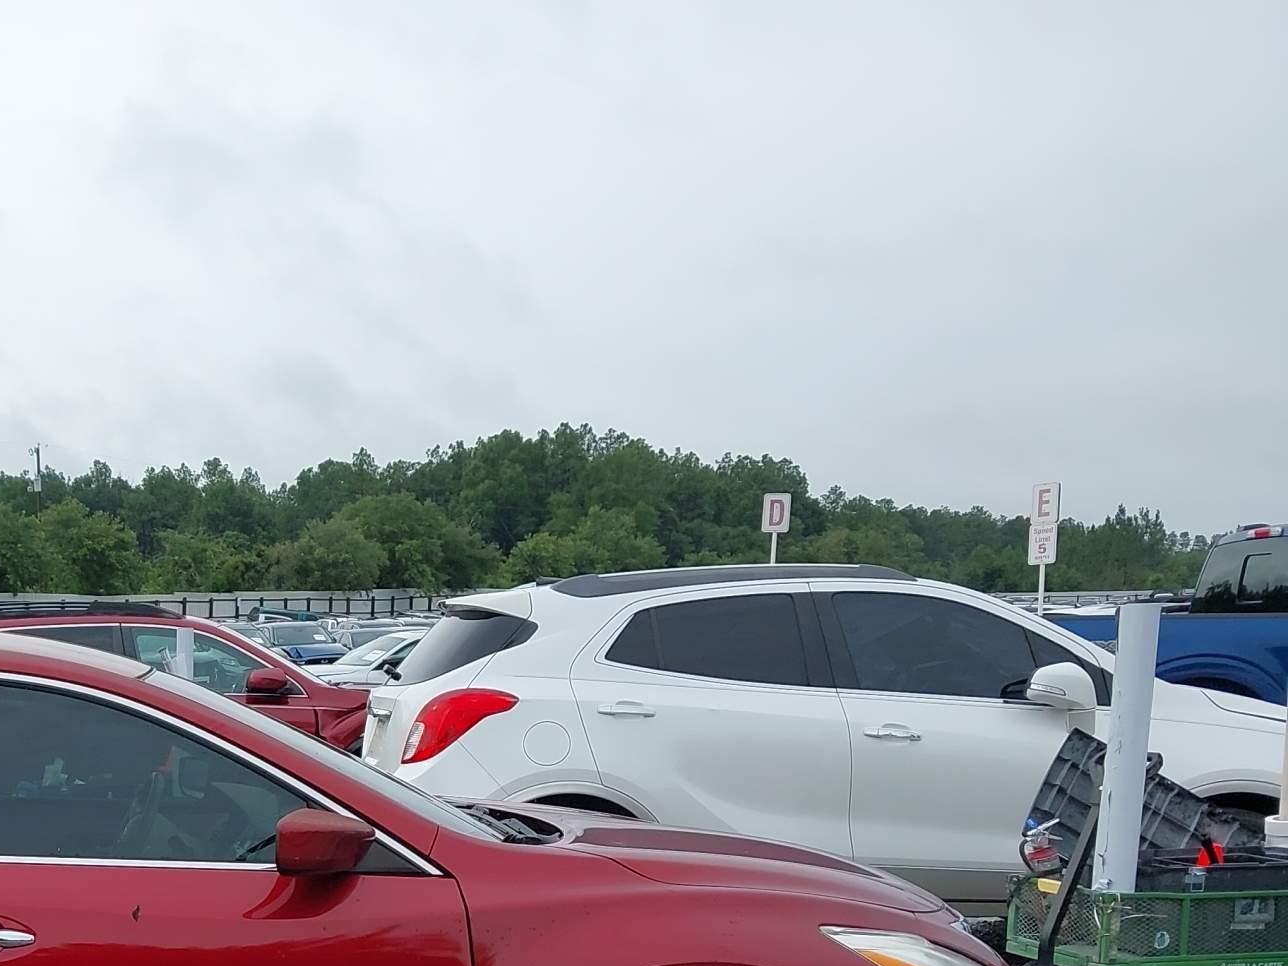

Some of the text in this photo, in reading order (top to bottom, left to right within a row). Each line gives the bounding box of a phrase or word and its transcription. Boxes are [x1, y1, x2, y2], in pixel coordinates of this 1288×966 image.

[768, 499, 785, 527] D
[1037, 488, 1051, 518] E
[1037, 543, 1047, 554] 5
